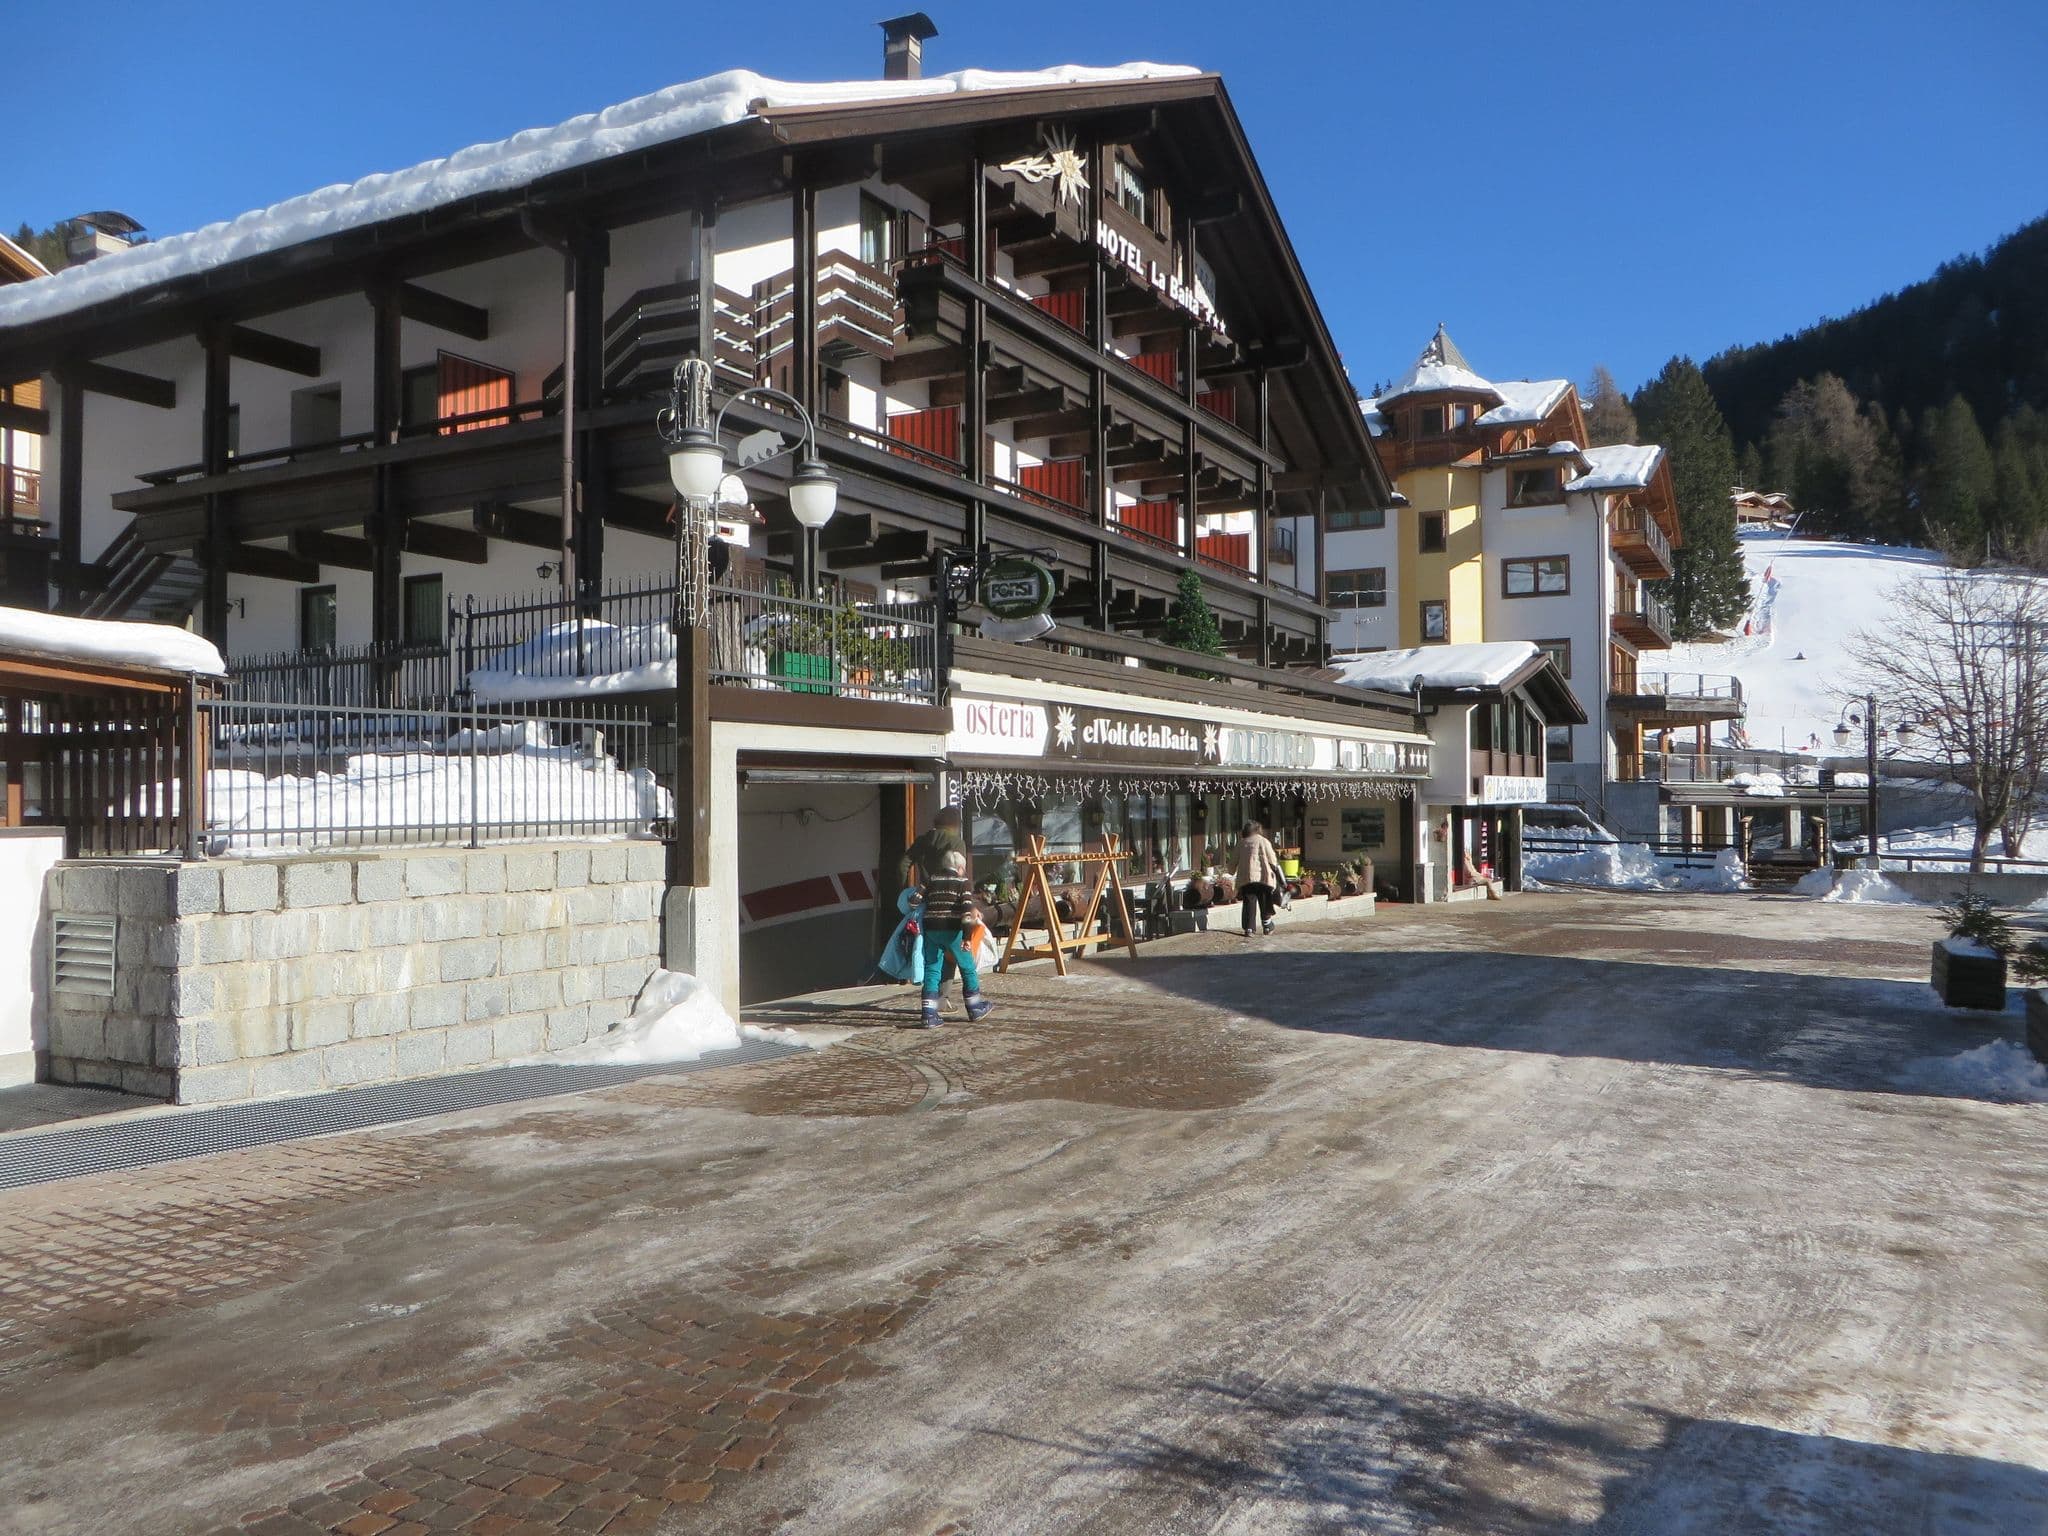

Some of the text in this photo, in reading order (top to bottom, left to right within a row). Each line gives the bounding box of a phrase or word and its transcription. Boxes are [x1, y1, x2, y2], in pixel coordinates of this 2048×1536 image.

[1096, 219, 1145, 275] HOTEL
[1151, 260, 1166, 291] La
[1169, 274, 1200, 316] Baita
[966, 699, 1034, 739] osteria
